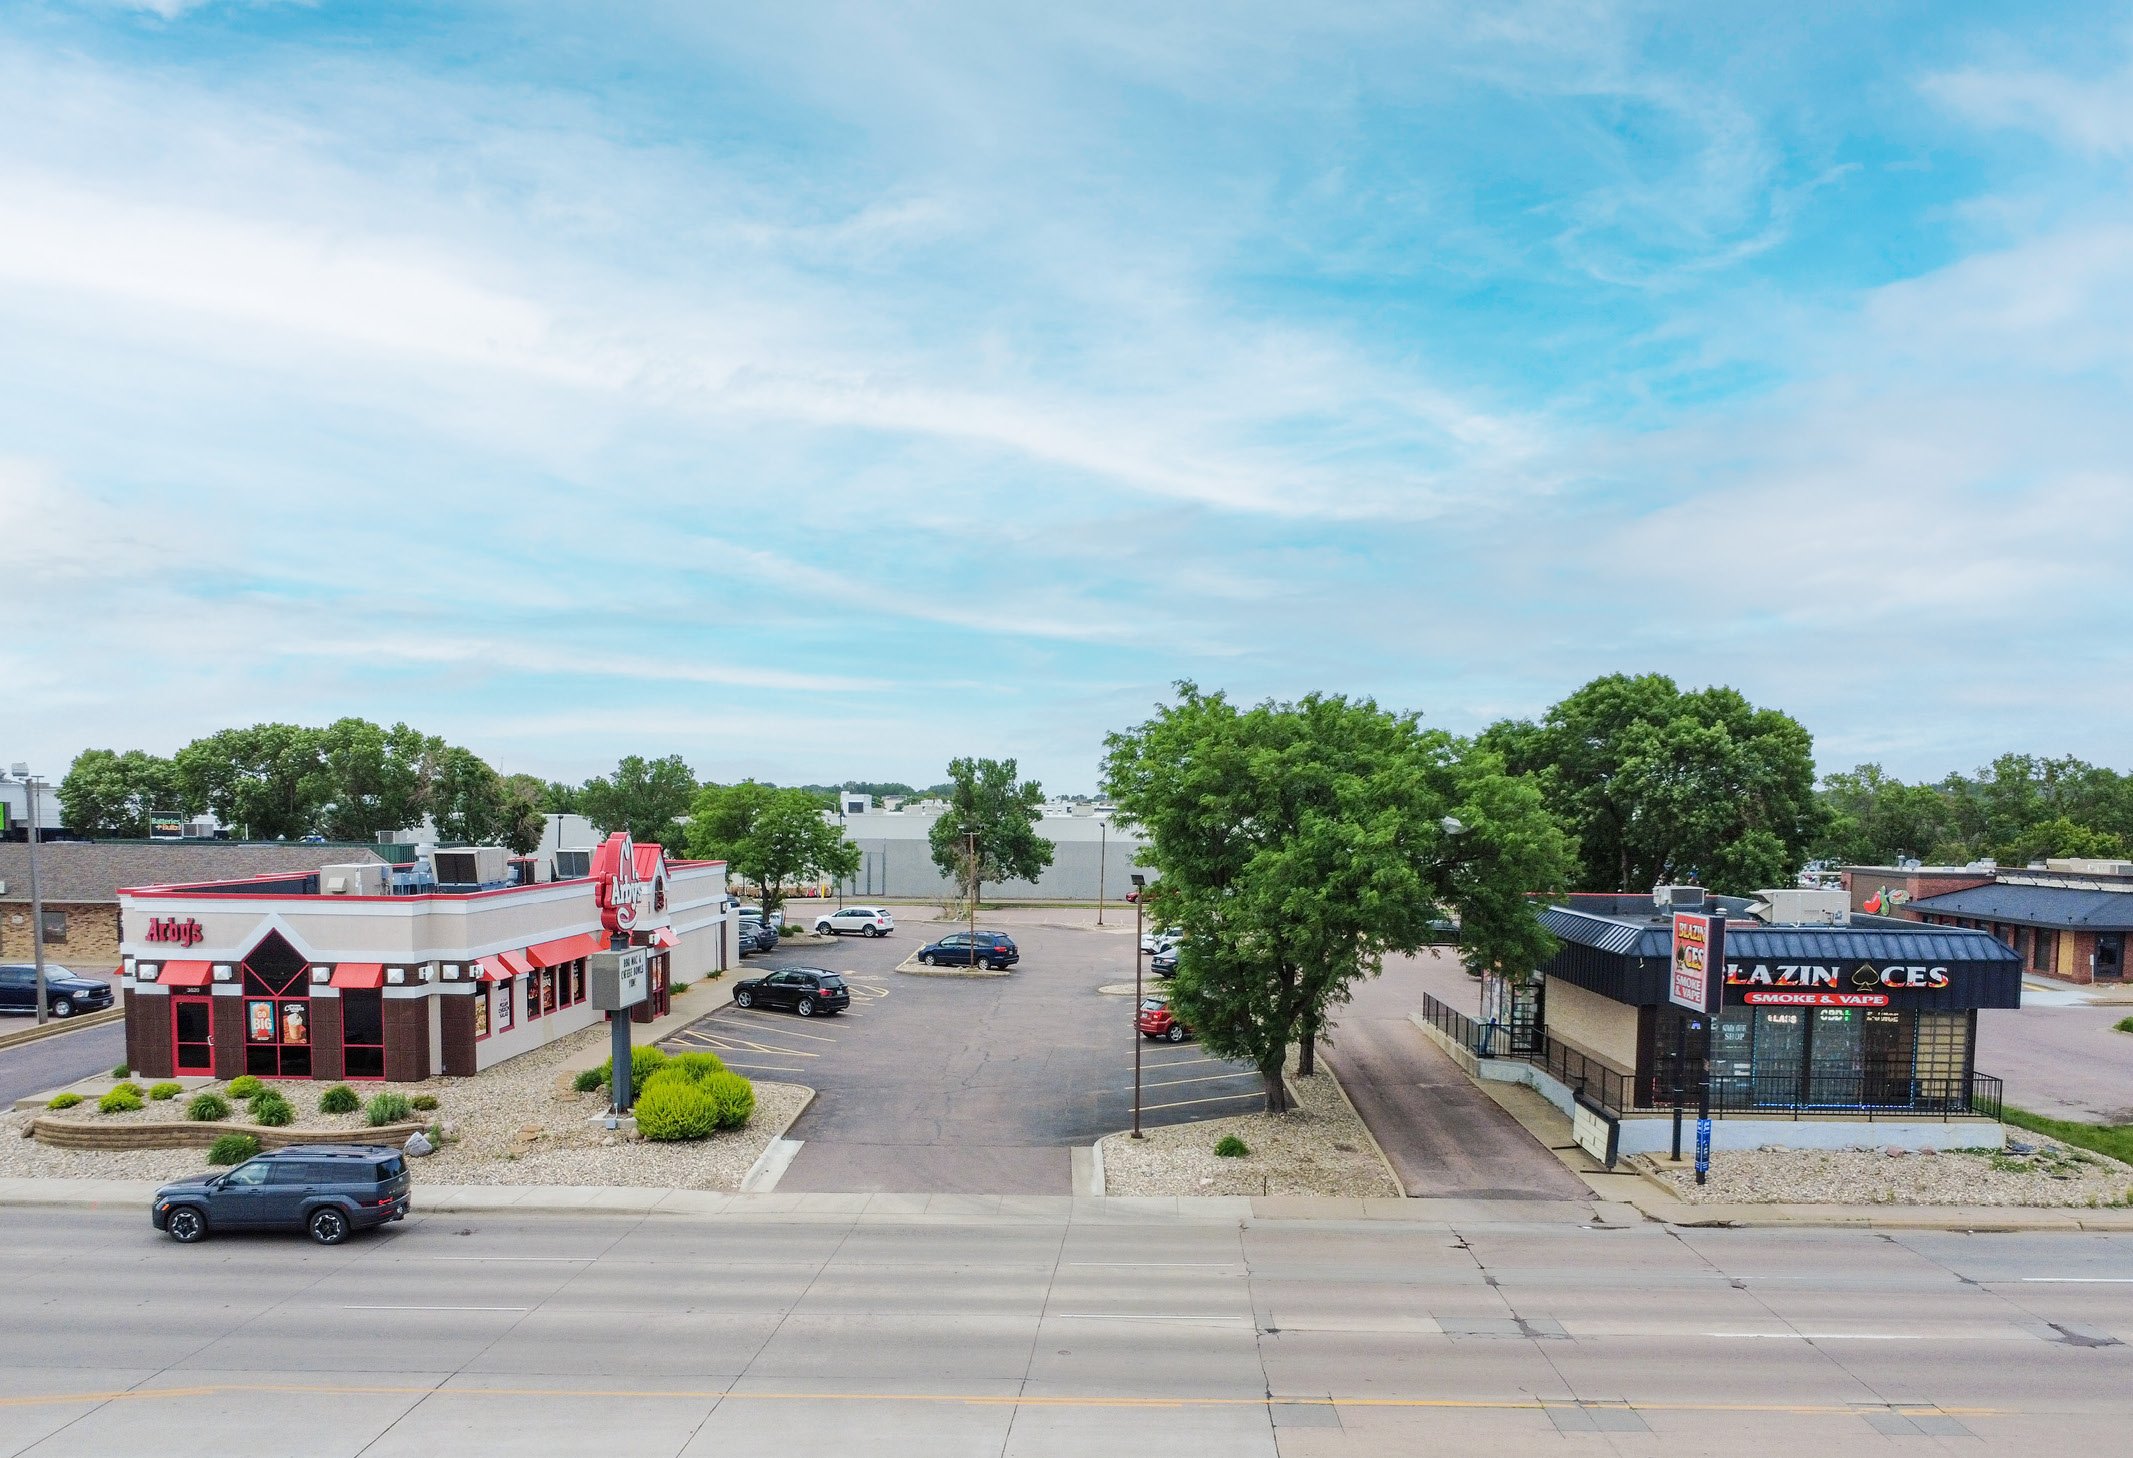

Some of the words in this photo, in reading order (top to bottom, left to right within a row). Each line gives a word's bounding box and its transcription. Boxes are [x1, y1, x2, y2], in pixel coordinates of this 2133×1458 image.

[151, 817, 181, 825] Batteries
[612, 871, 642, 911] Arby's
[145, 917, 204, 948] Arby's
[1678, 922, 1706, 944] BLAZIN
[1675, 975, 1701, 990] SMOKE
[1722, 963, 1840, 988] LAZIN
[1682, 987, 1701, 1001] VAPE
[1751, 994, 1816, 1004] SMOKE
[1819, 993, 1836, 1004] &
[1839, 995, 1884, 1005] VAPE
[255, 1018, 273, 1030] BIG
[1724, 1032, 1745, 1040] SHOP
